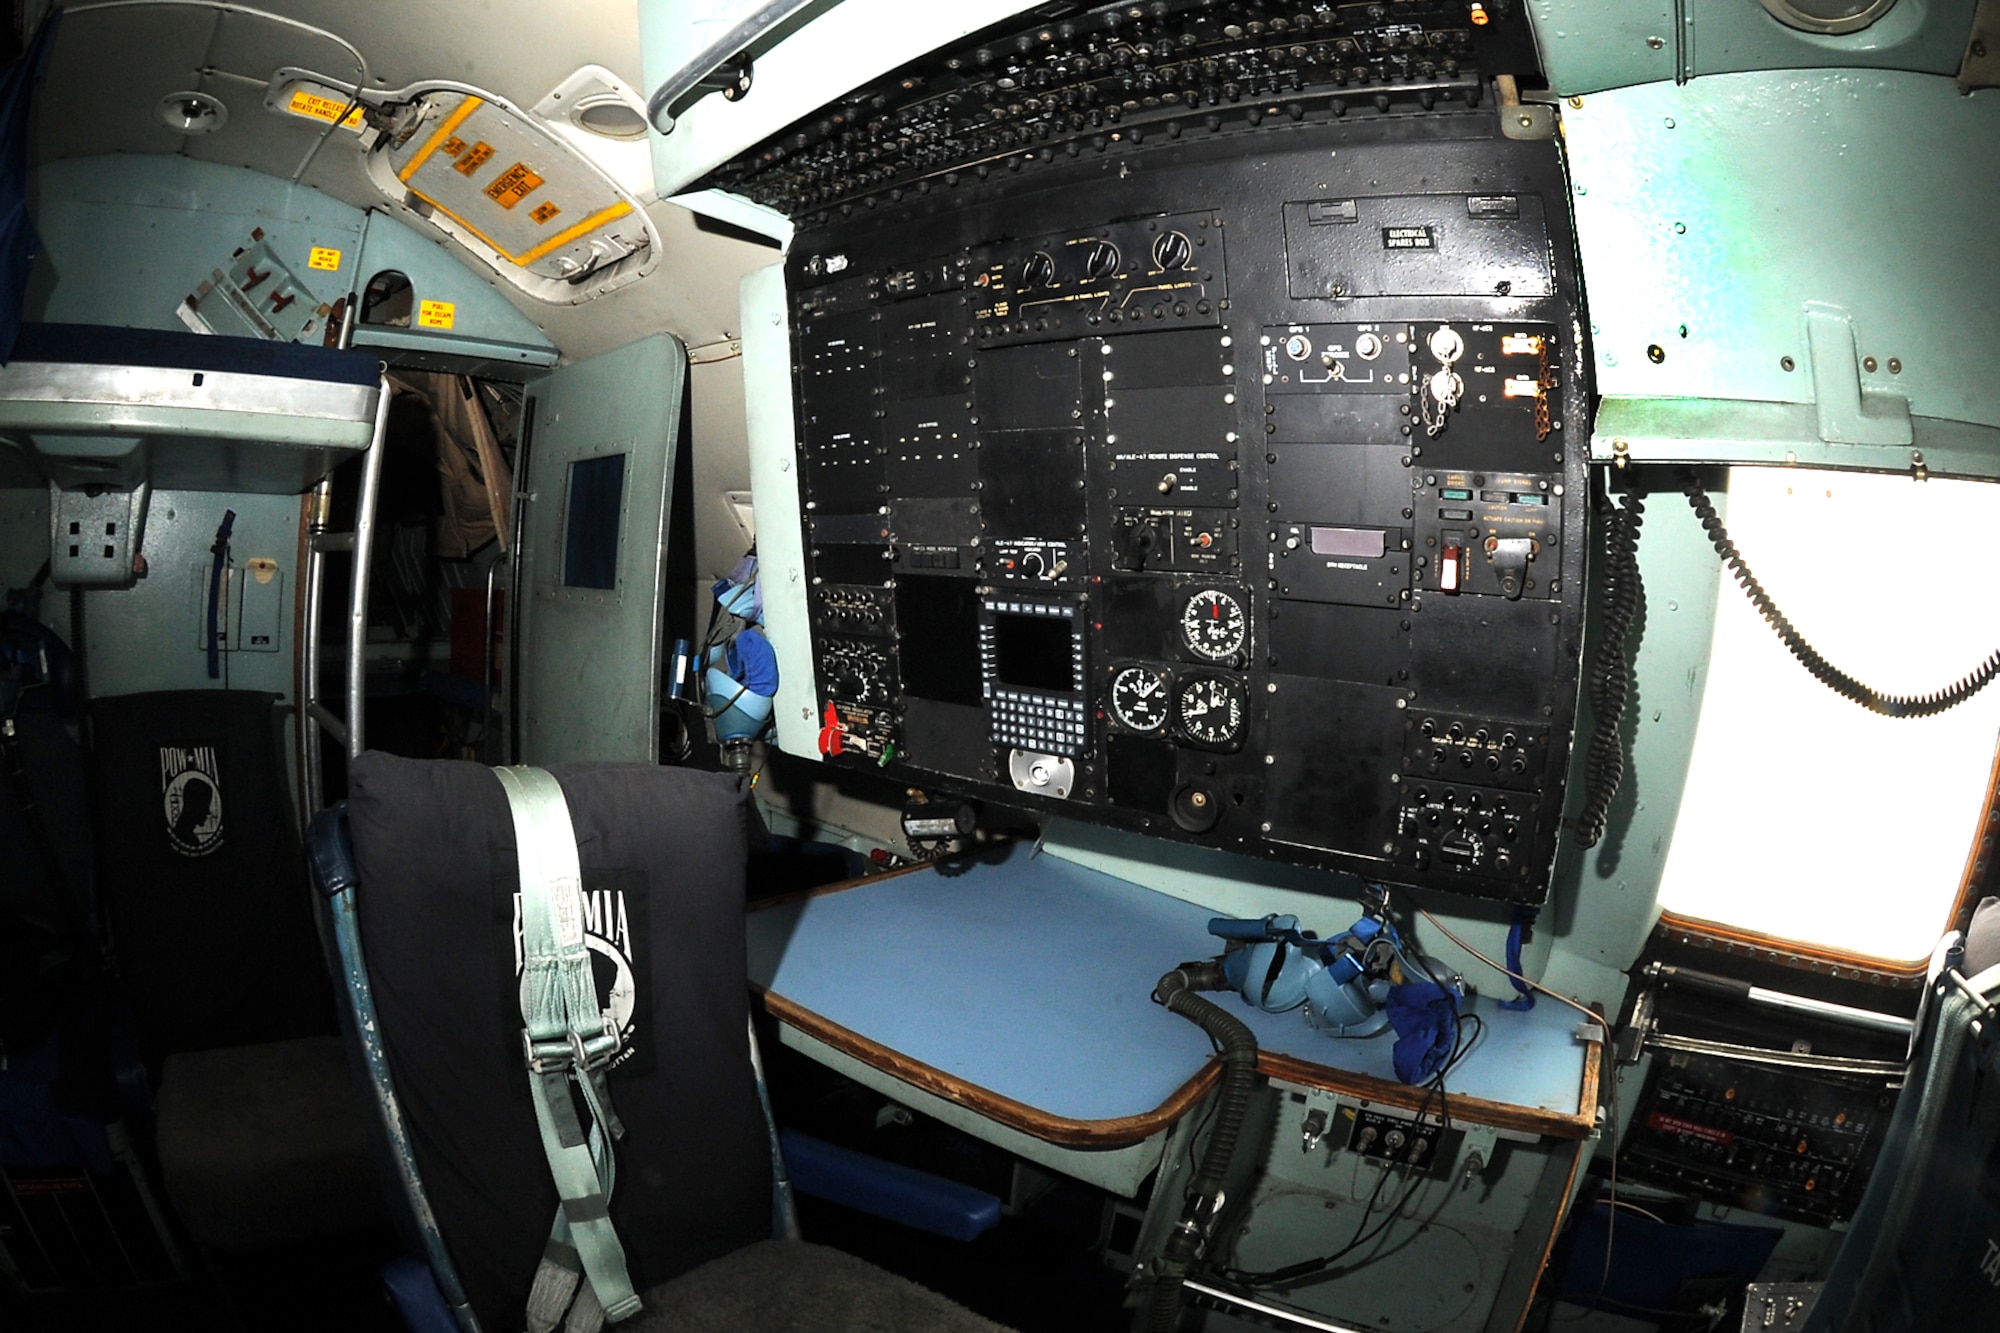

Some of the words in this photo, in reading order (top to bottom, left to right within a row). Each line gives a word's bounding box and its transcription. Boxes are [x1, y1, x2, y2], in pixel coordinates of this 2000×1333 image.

[307, 97, 321, 105] EXIT
[322, 101, 345, 113] RELEAS
[314, 108, 337, 119] HANDLE
[487, 165, 529, 199] EMERGENCY
[510, 180, 531, 197] EXIT
[1389, 229, 1427, 238] ELECTRICAL
[1388, 238, 1413, 247] SPARES
[1414, 238, 1430, 247] BOX
[434, 311, 451, 319] ESCAPE
[429, 318, 442, 326] ROPE
[1357, 324, 1372, 332] GPS
[1327, 344, 1343, 352] GPS
[160, 747, 187, 794] POW
[193, 746, 220, 789] MIA
[582, 889, 634, 965] MIA
